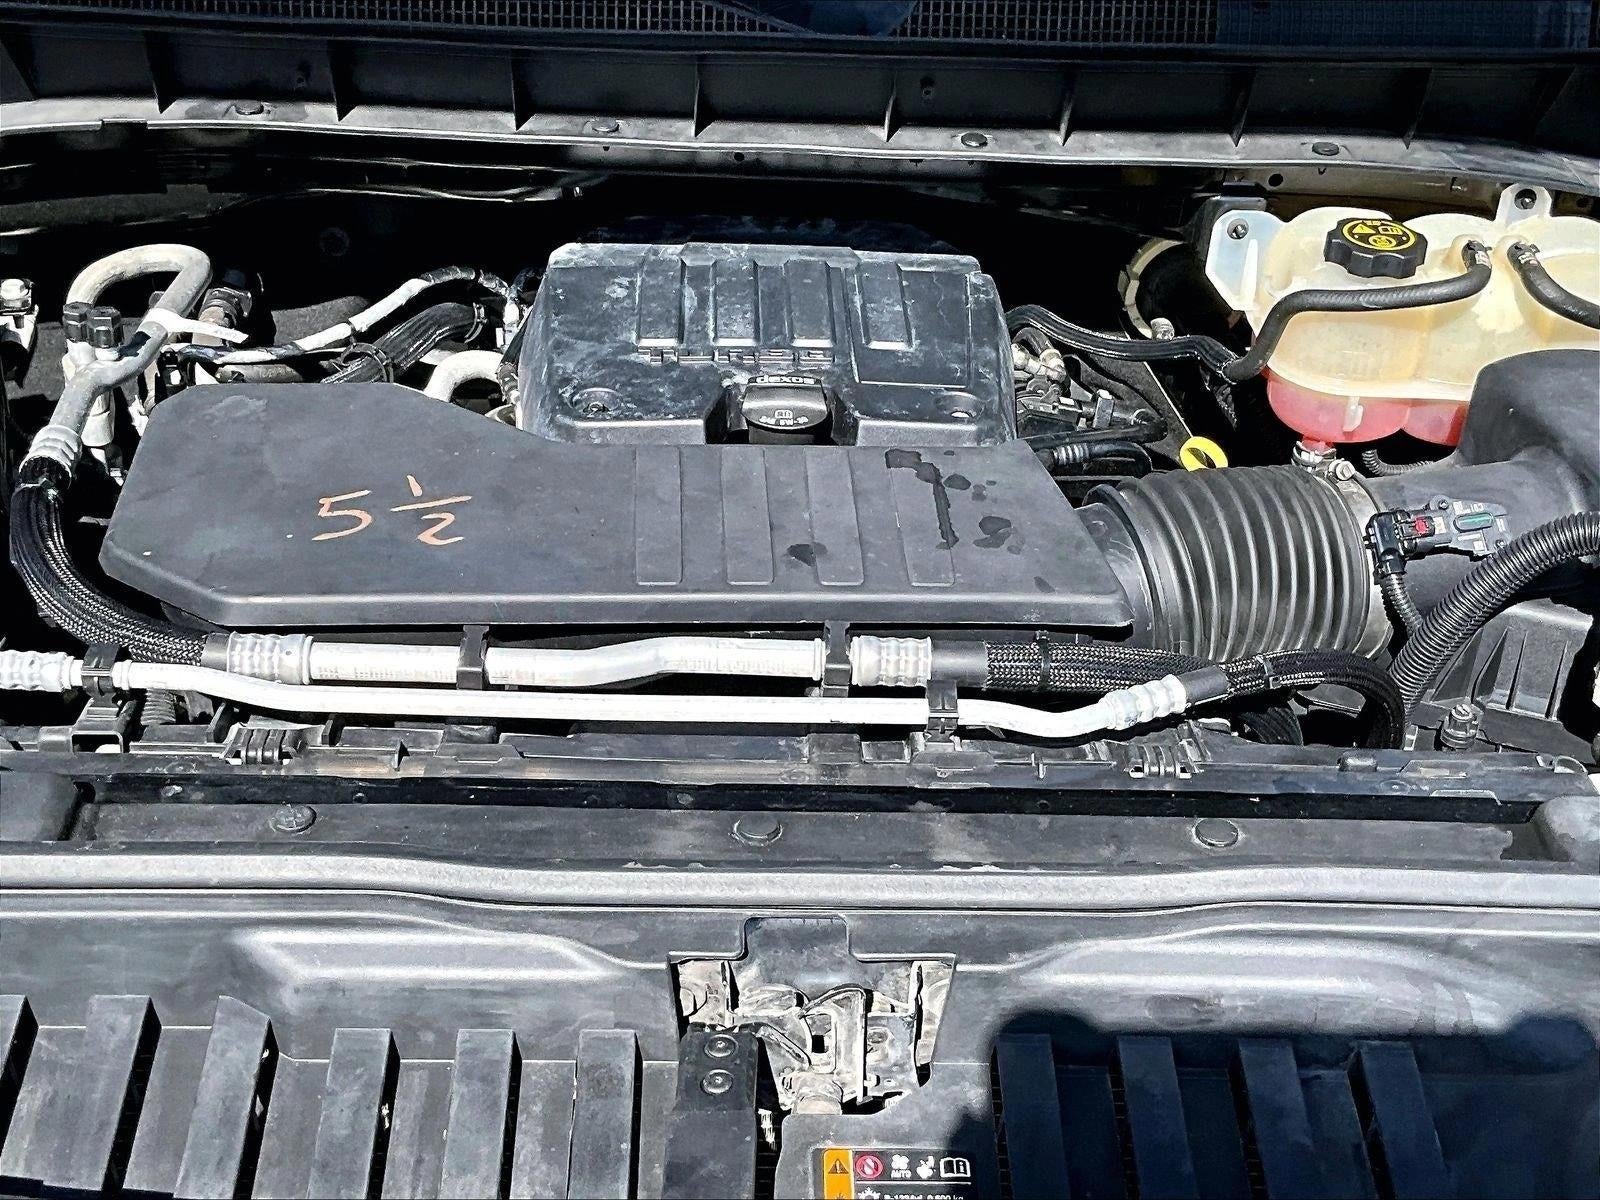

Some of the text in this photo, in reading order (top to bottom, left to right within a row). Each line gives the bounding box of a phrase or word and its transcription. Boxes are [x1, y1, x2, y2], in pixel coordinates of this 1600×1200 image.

[756, 374, 815, 385] dexos
[312, 489, 372, 541] 5
[891, 1170, 912, 1178] AUTO
